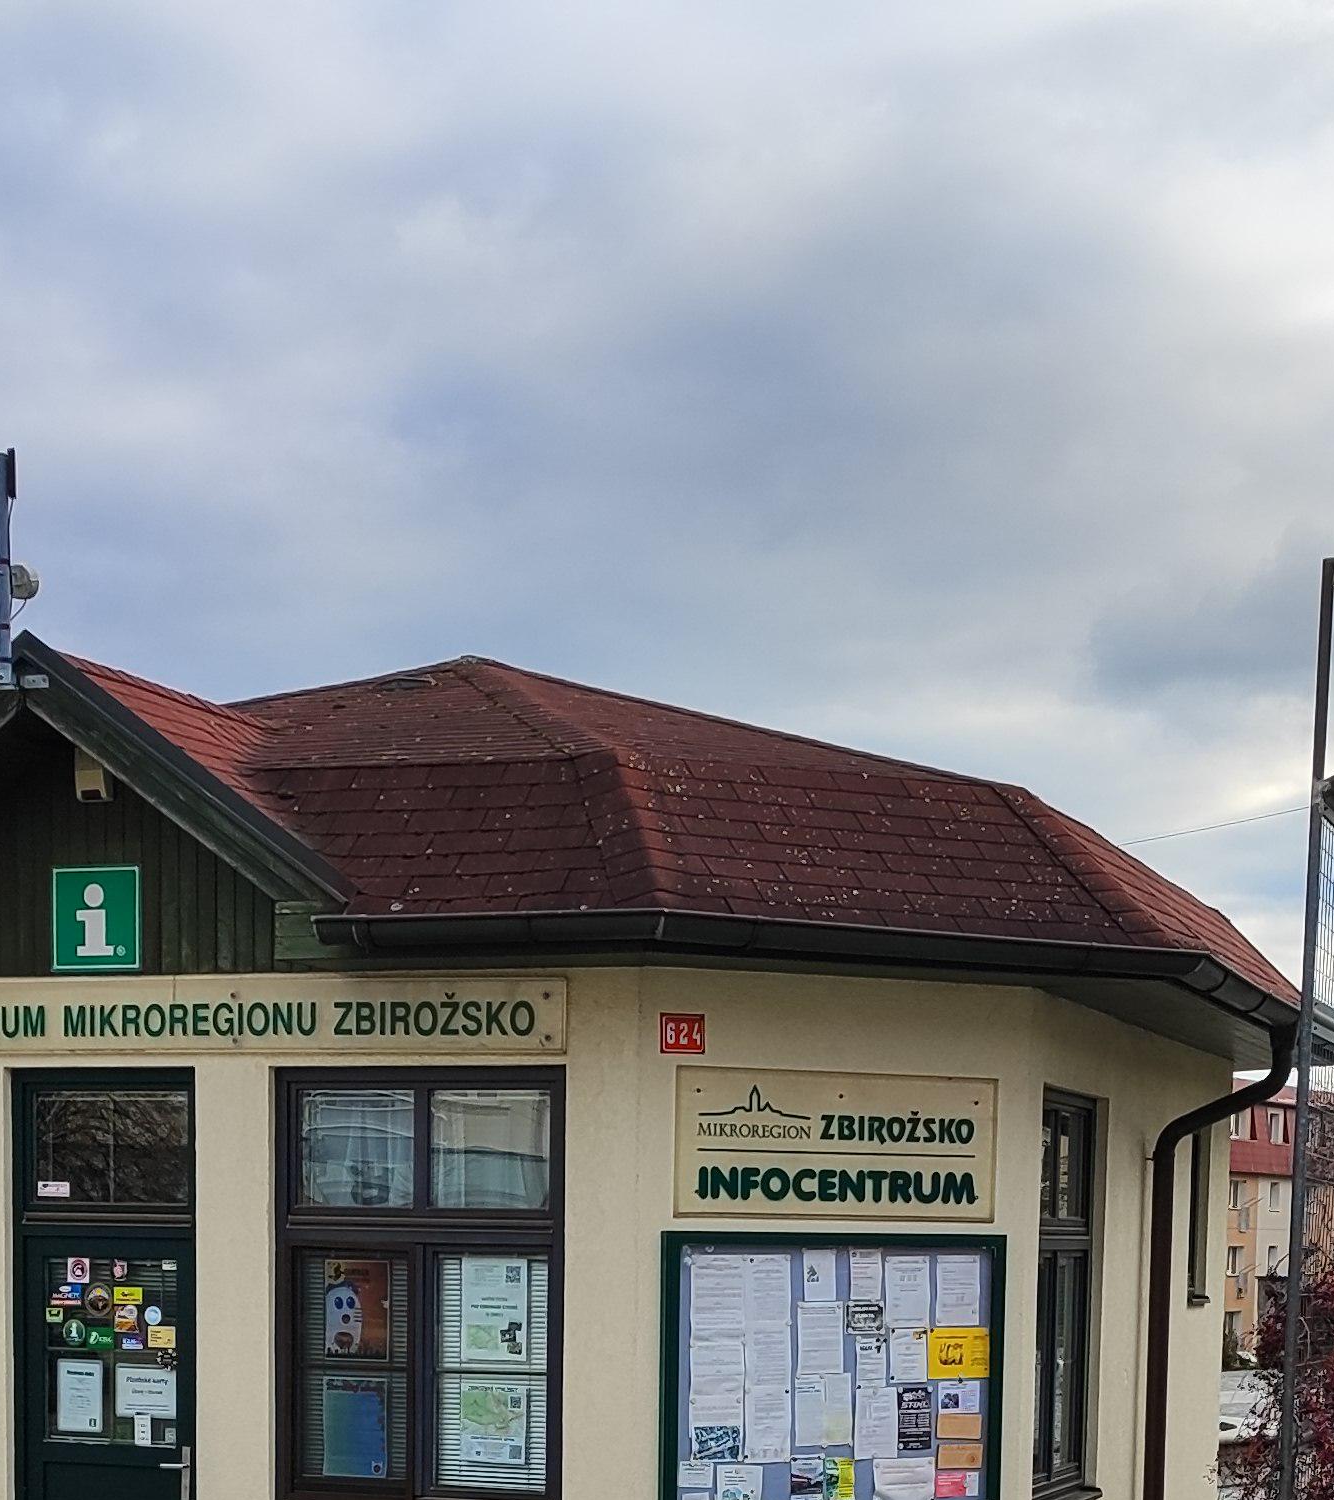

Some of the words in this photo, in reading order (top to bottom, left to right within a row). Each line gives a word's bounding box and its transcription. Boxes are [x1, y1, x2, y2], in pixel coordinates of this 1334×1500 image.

[62, 1001, 317, 1038] MIKROREGIONU
[333, 991, 536, 1037] ZBIROŽSKO
[666, 1022, 701, 1046] 624
[696, 1121, 812, 1139] MIKROREGION
[819, 1110, 975, 1145] ZBIROŽSKO
[696, 1165, 978, 1205] INFOCENTRUM
